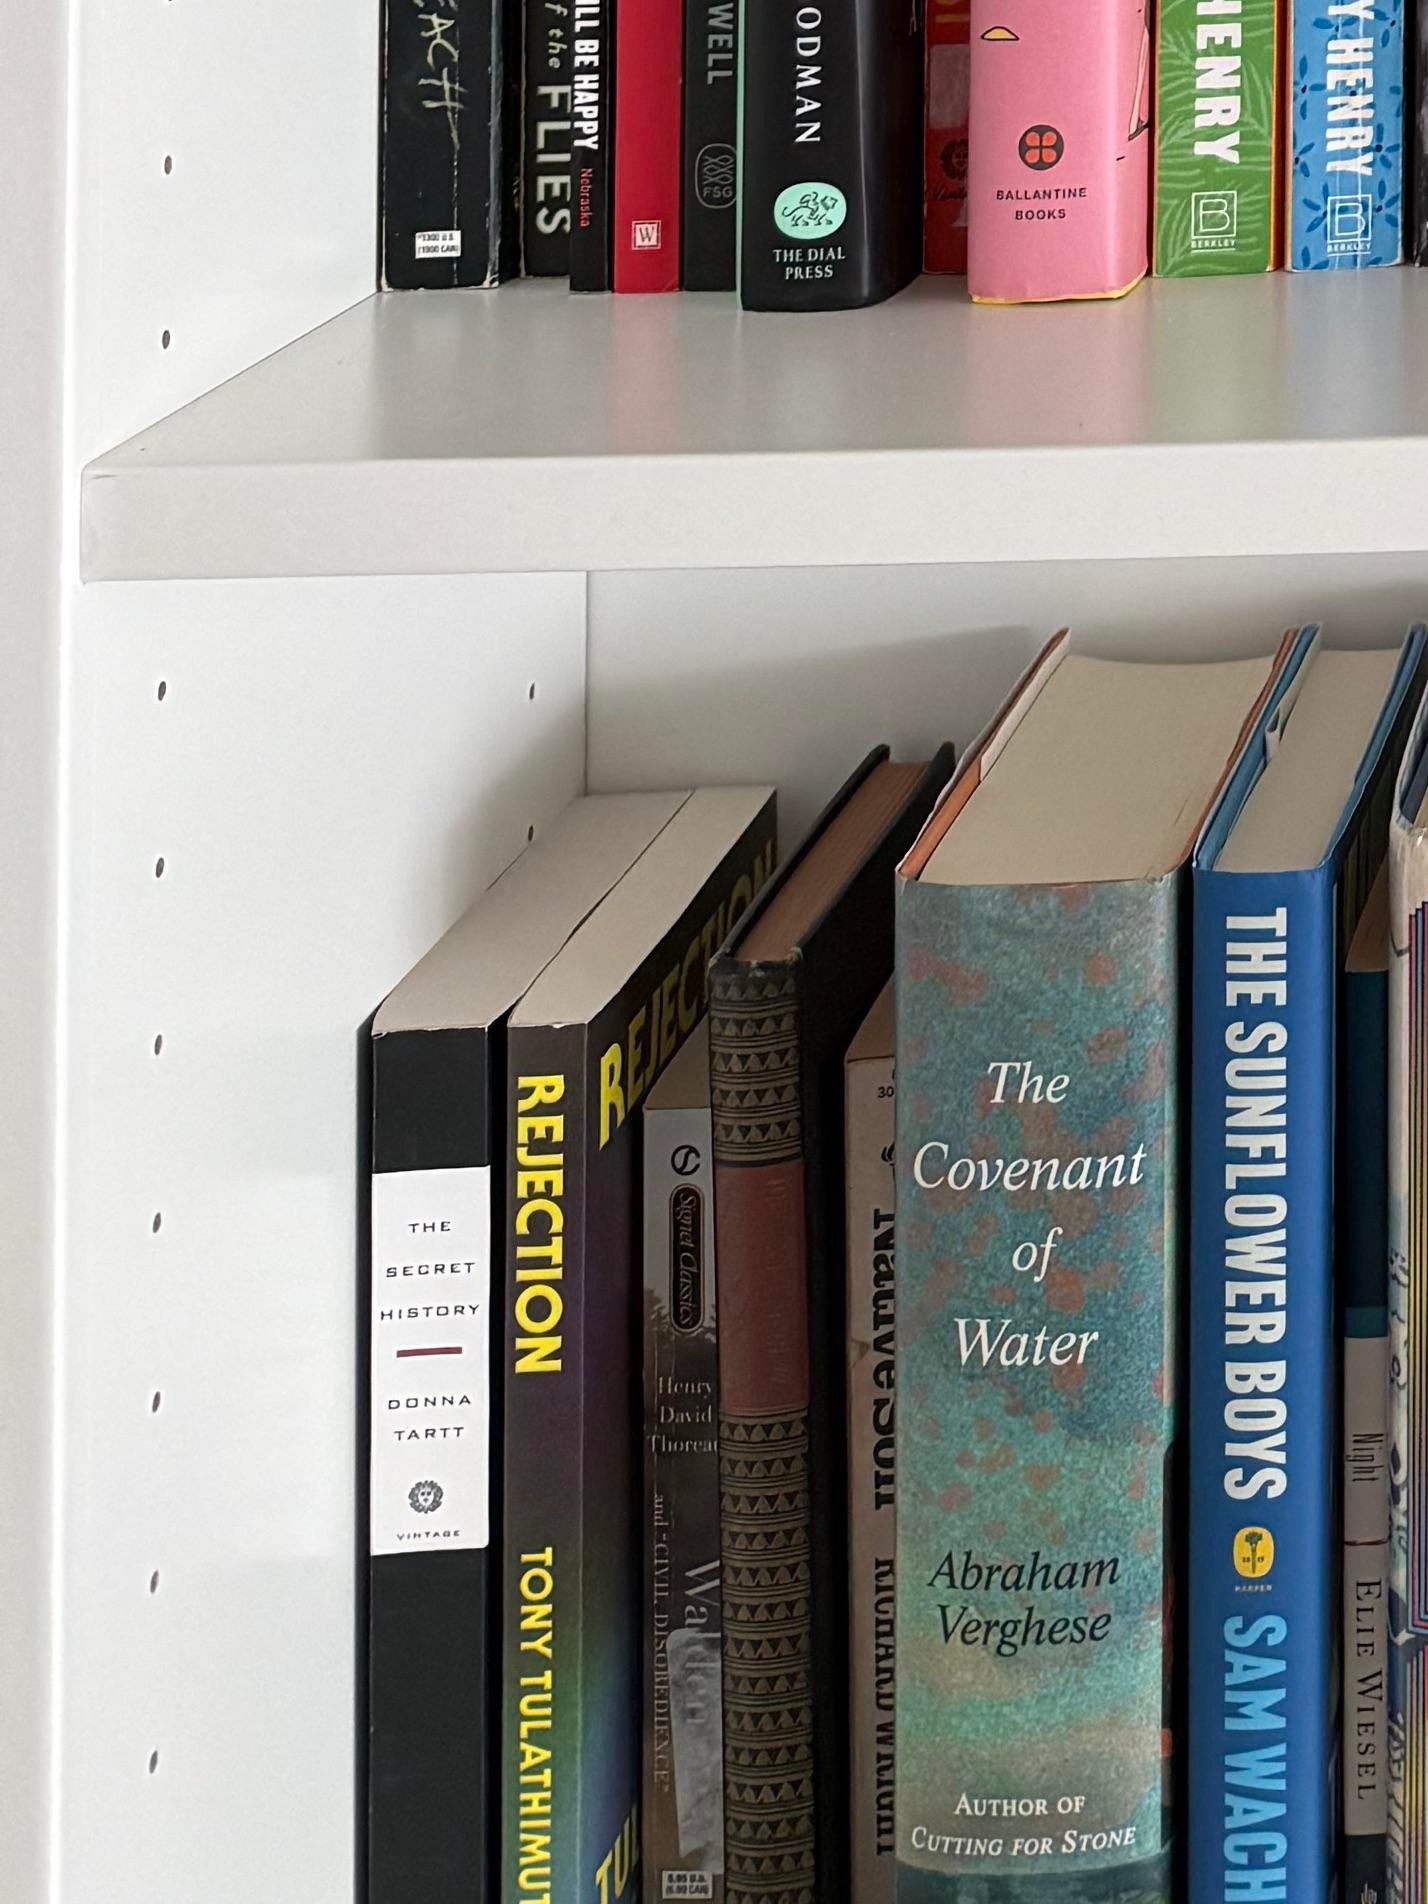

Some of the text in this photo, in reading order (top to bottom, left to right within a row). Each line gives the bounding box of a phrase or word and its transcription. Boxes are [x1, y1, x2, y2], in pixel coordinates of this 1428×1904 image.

[997, 188, 1086, 200] BALLANTINE
[1015, 209, 1065, 220] BOOKS
[773, 247, 845, 262] THE DIAL
[784, 265, 833, 279] PRESS
[988, 1061, 1069, 1103] The
[914, 1142, 1147, 1191] Covenant
[1224, 907, 1287, 1499] THE SUNFLOWER BOYS
[409, 1222, 450, 1232] THE
[515, 1075, 564, 1373] REJECTION
[1013, 1228, 1063, 1282] of
[387, 1263, 473, 1277] SECRET
[381, 1305, 478, 1320] HISTORY
[955, 1319, 1098, 1366] Water
[389, 1396, 470, 1409] DONNA
[395, 1427, 463, 1440] TARTT
[1347, 1434, 1383, 1481] Night
[397, 1530, 459, 1540] VINTAGE
[928, 1551, 1118, 1591] Abraham
[938, 1604, 1111, 1650] Verghese
[1356, 1581, 1383, 1799] ELIE WIESEL
[955, 1793, 1085, 1816] AUTHOR OF
[912, 1827, 1137, 1856] CUTTING FOR STONE
